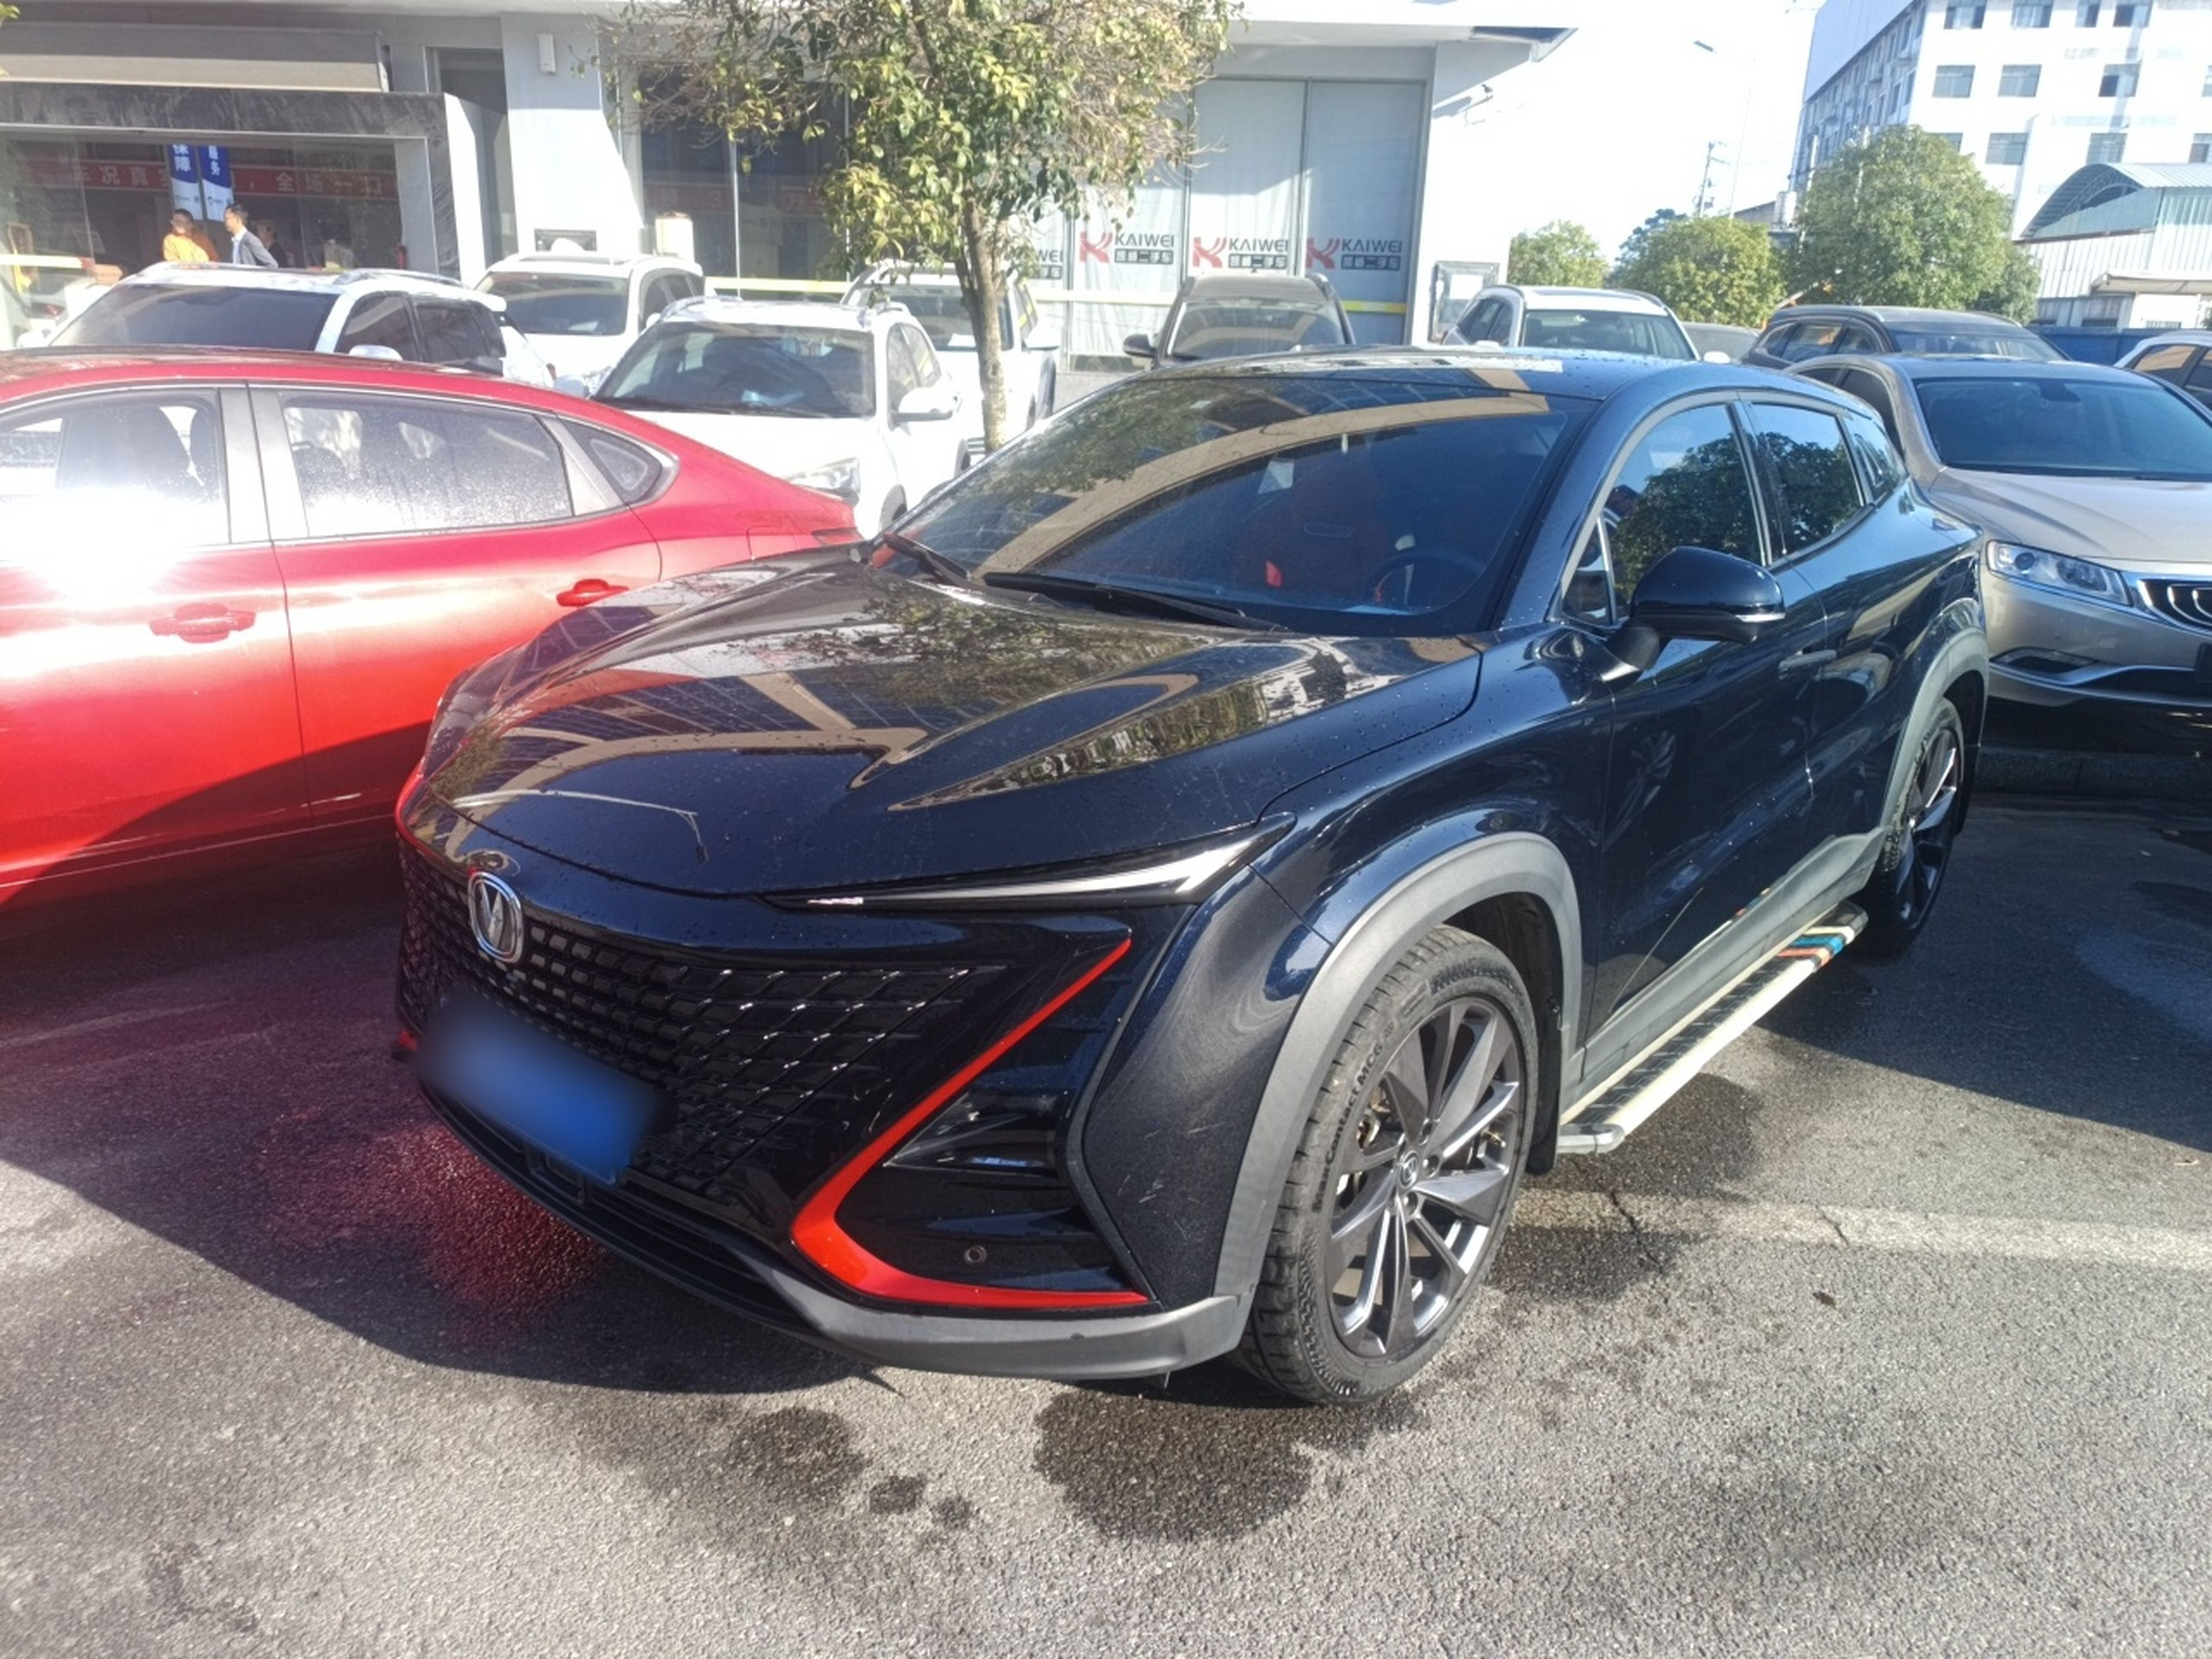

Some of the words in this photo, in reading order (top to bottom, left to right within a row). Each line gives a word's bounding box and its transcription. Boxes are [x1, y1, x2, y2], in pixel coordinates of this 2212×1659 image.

[1115, 233, 1174, 248] KAIWEI
[1228, 238, 1289, 252] KAIWEI
[1342, 238, 1402, 253] KAIWEI
